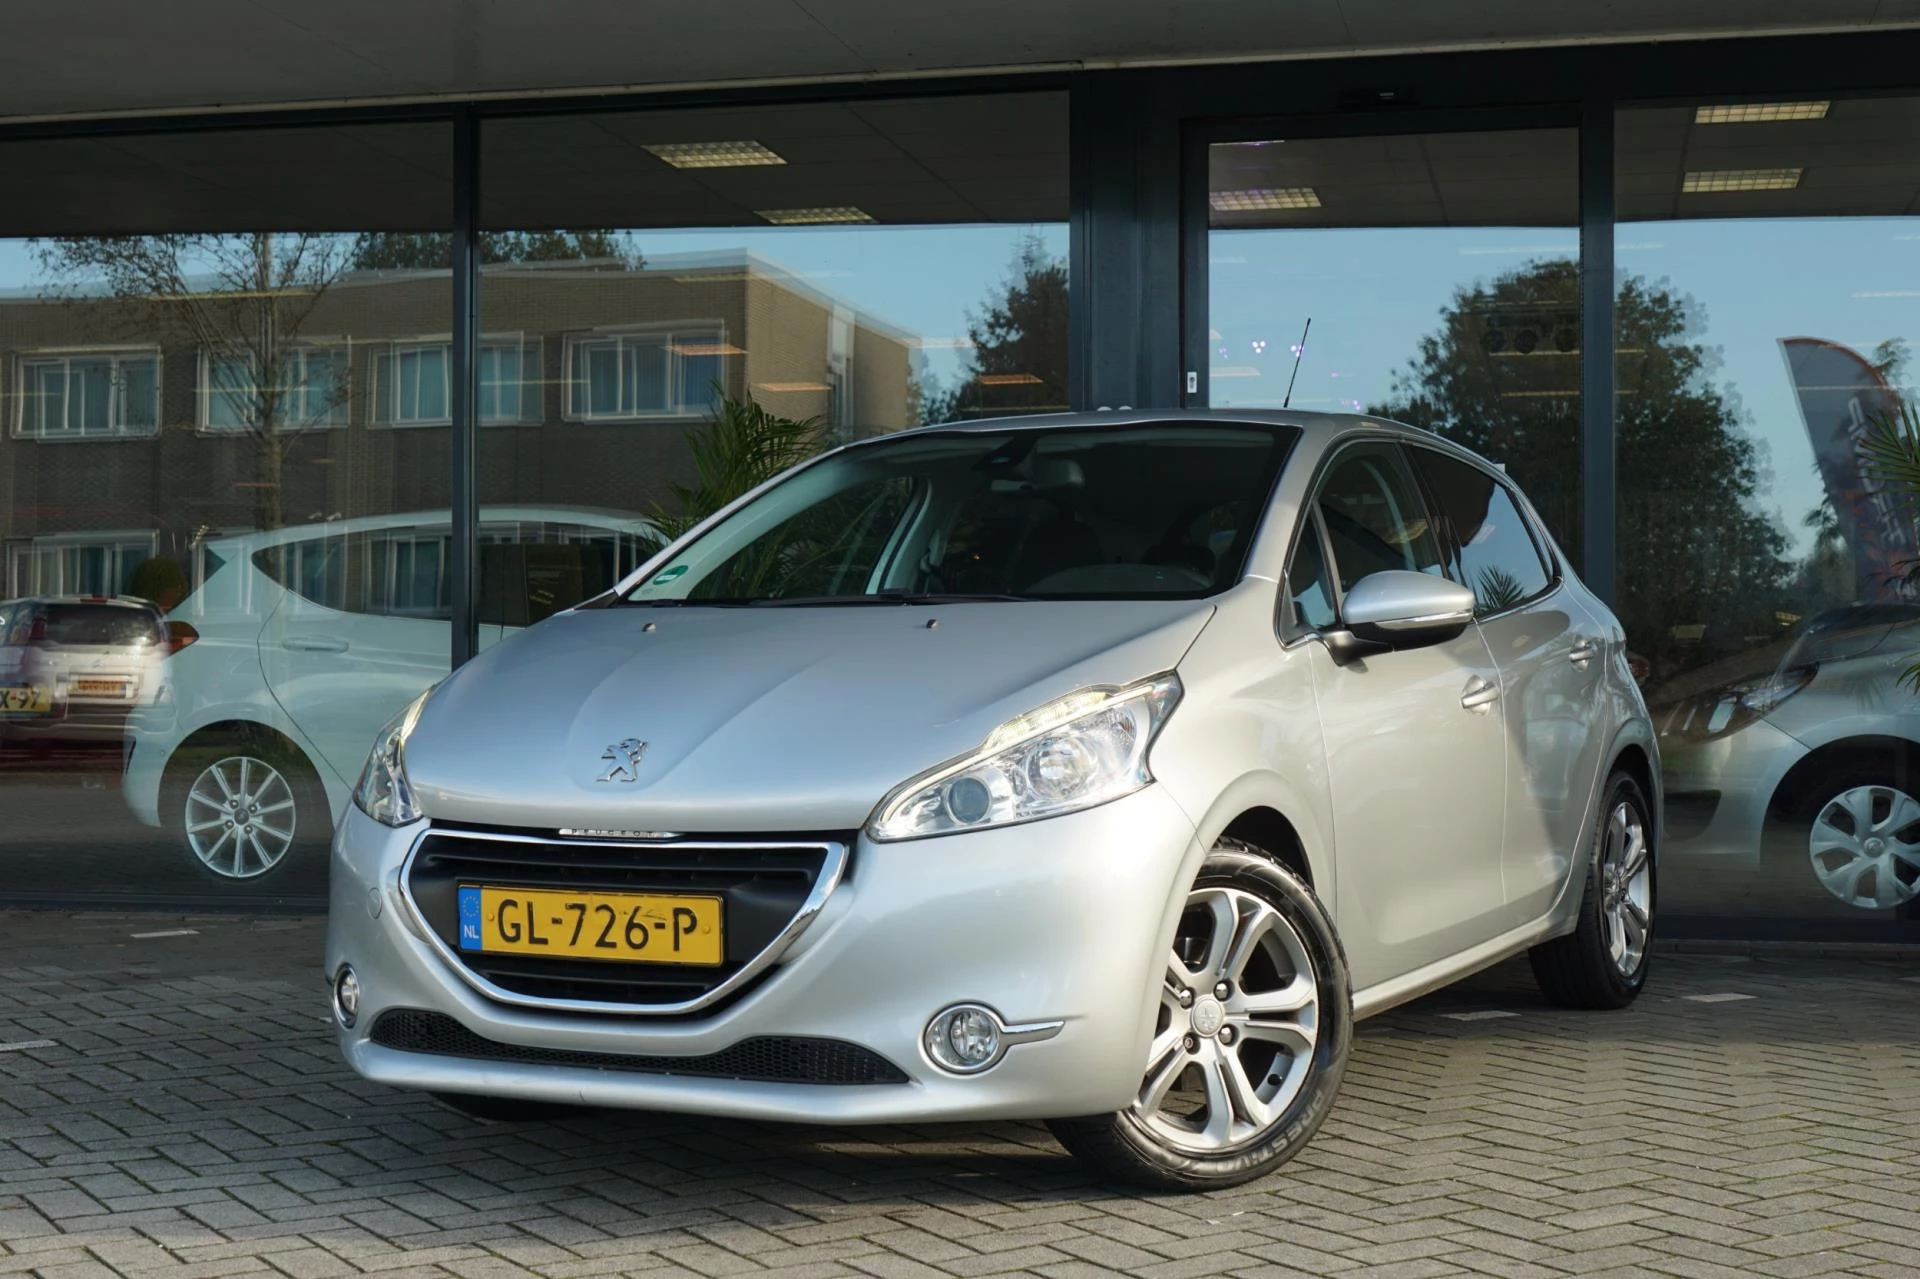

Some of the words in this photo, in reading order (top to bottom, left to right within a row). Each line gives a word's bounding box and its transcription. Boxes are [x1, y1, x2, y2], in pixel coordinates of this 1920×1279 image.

[571, 829, 654, 838] PEUGEOT
[464, 924, 479, 938] NL
[497, 898, 698, 952] GL-726-P
